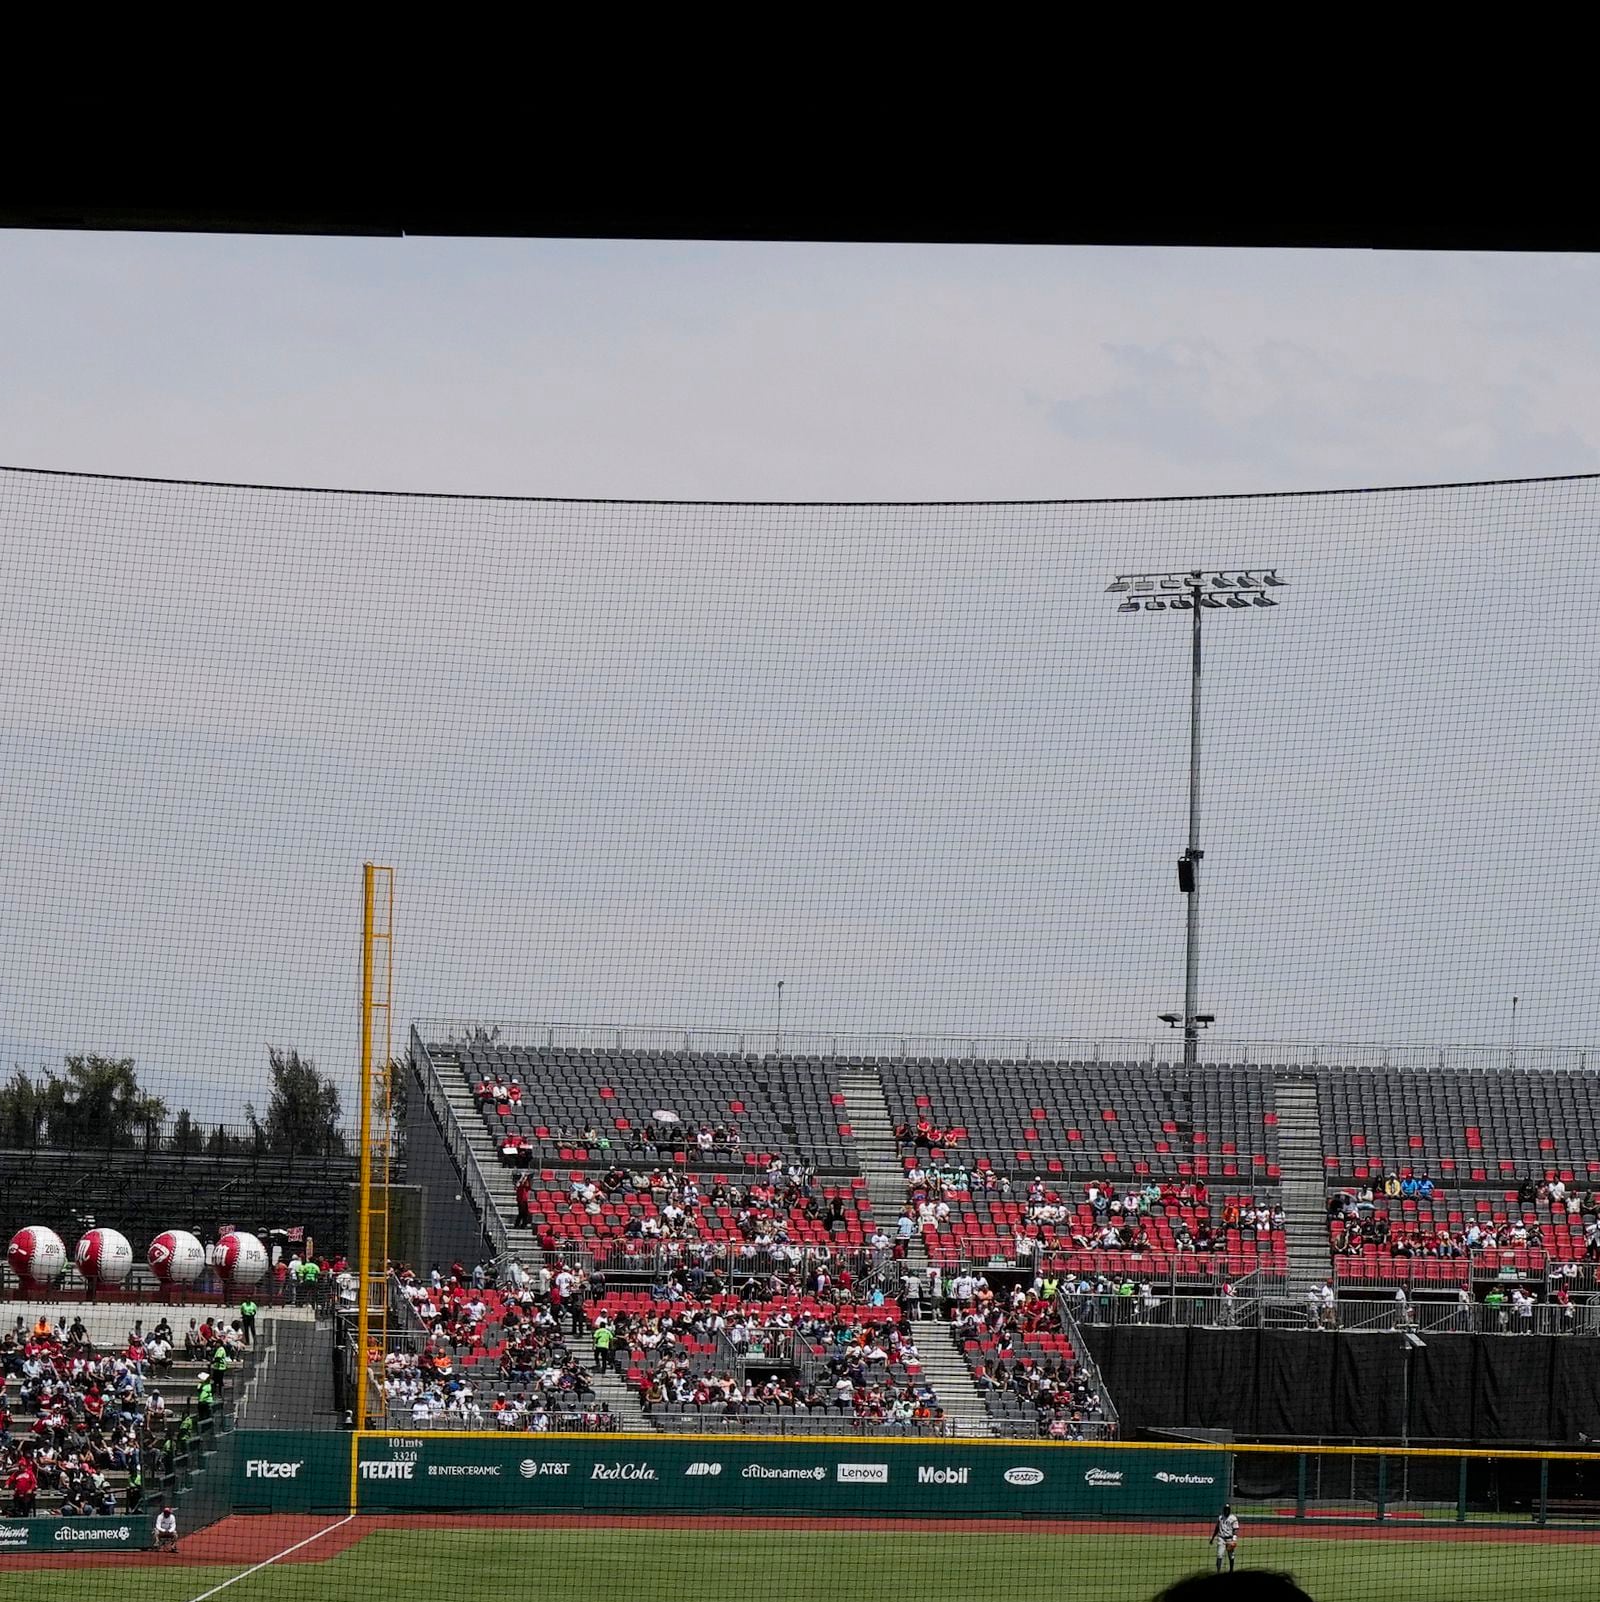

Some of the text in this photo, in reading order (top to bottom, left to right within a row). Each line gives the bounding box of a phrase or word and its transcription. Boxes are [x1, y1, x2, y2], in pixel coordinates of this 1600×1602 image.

[388, 1438, 424, 1449] 101mts
[393, 1451, 418, 1462] 332ft
[246, 1460, 300, 1478] Fitzer
[359, 1461, 417, 1479] TECATE
[438, 1465, 501, 1476] INTERCERAMIC
[539, 1463, 571, 1475] AT&T
[685, 1462, 722, 1476] ADO
[741, 1464, 813, 1480] citibanamex
[841, 1467, 883, 1479] Lenovo
[918, 1466, 968, 1484] Mobil
[1008, 1471, 1040, 1482] Fester
[1169, 1474, 1214, 1484] Profuturo
[55, 1526, 119, 1540] citibanamex
